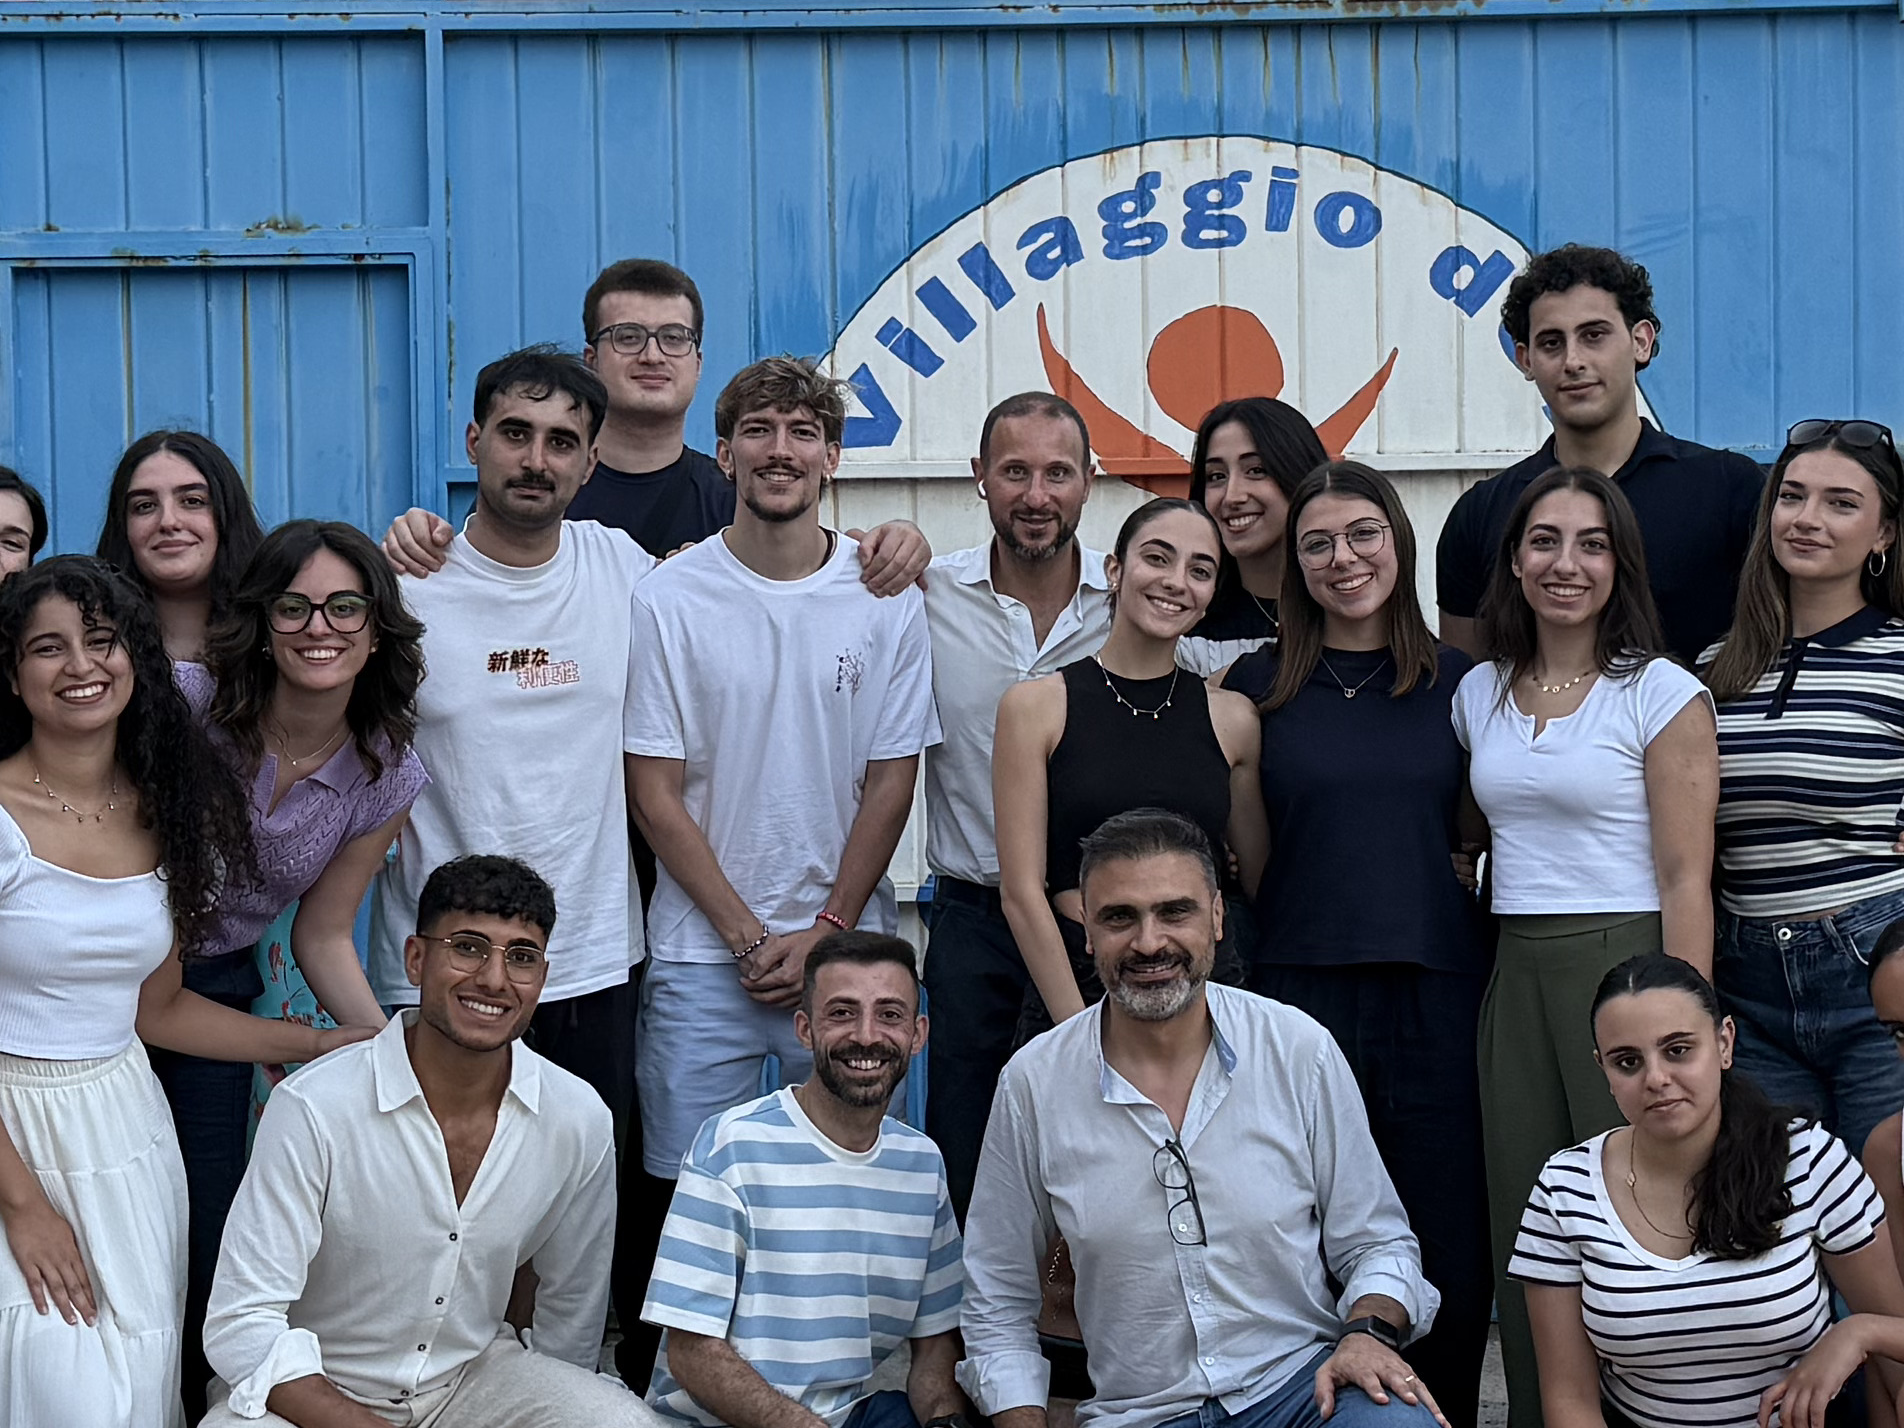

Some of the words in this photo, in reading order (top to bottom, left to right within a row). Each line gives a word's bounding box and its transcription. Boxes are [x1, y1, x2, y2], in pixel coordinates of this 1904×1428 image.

[842, 166, 1382, 448] Villaggio
[487, 647, 549, 673] 新鮮な
[517, 659, 580, 689] 利便性
